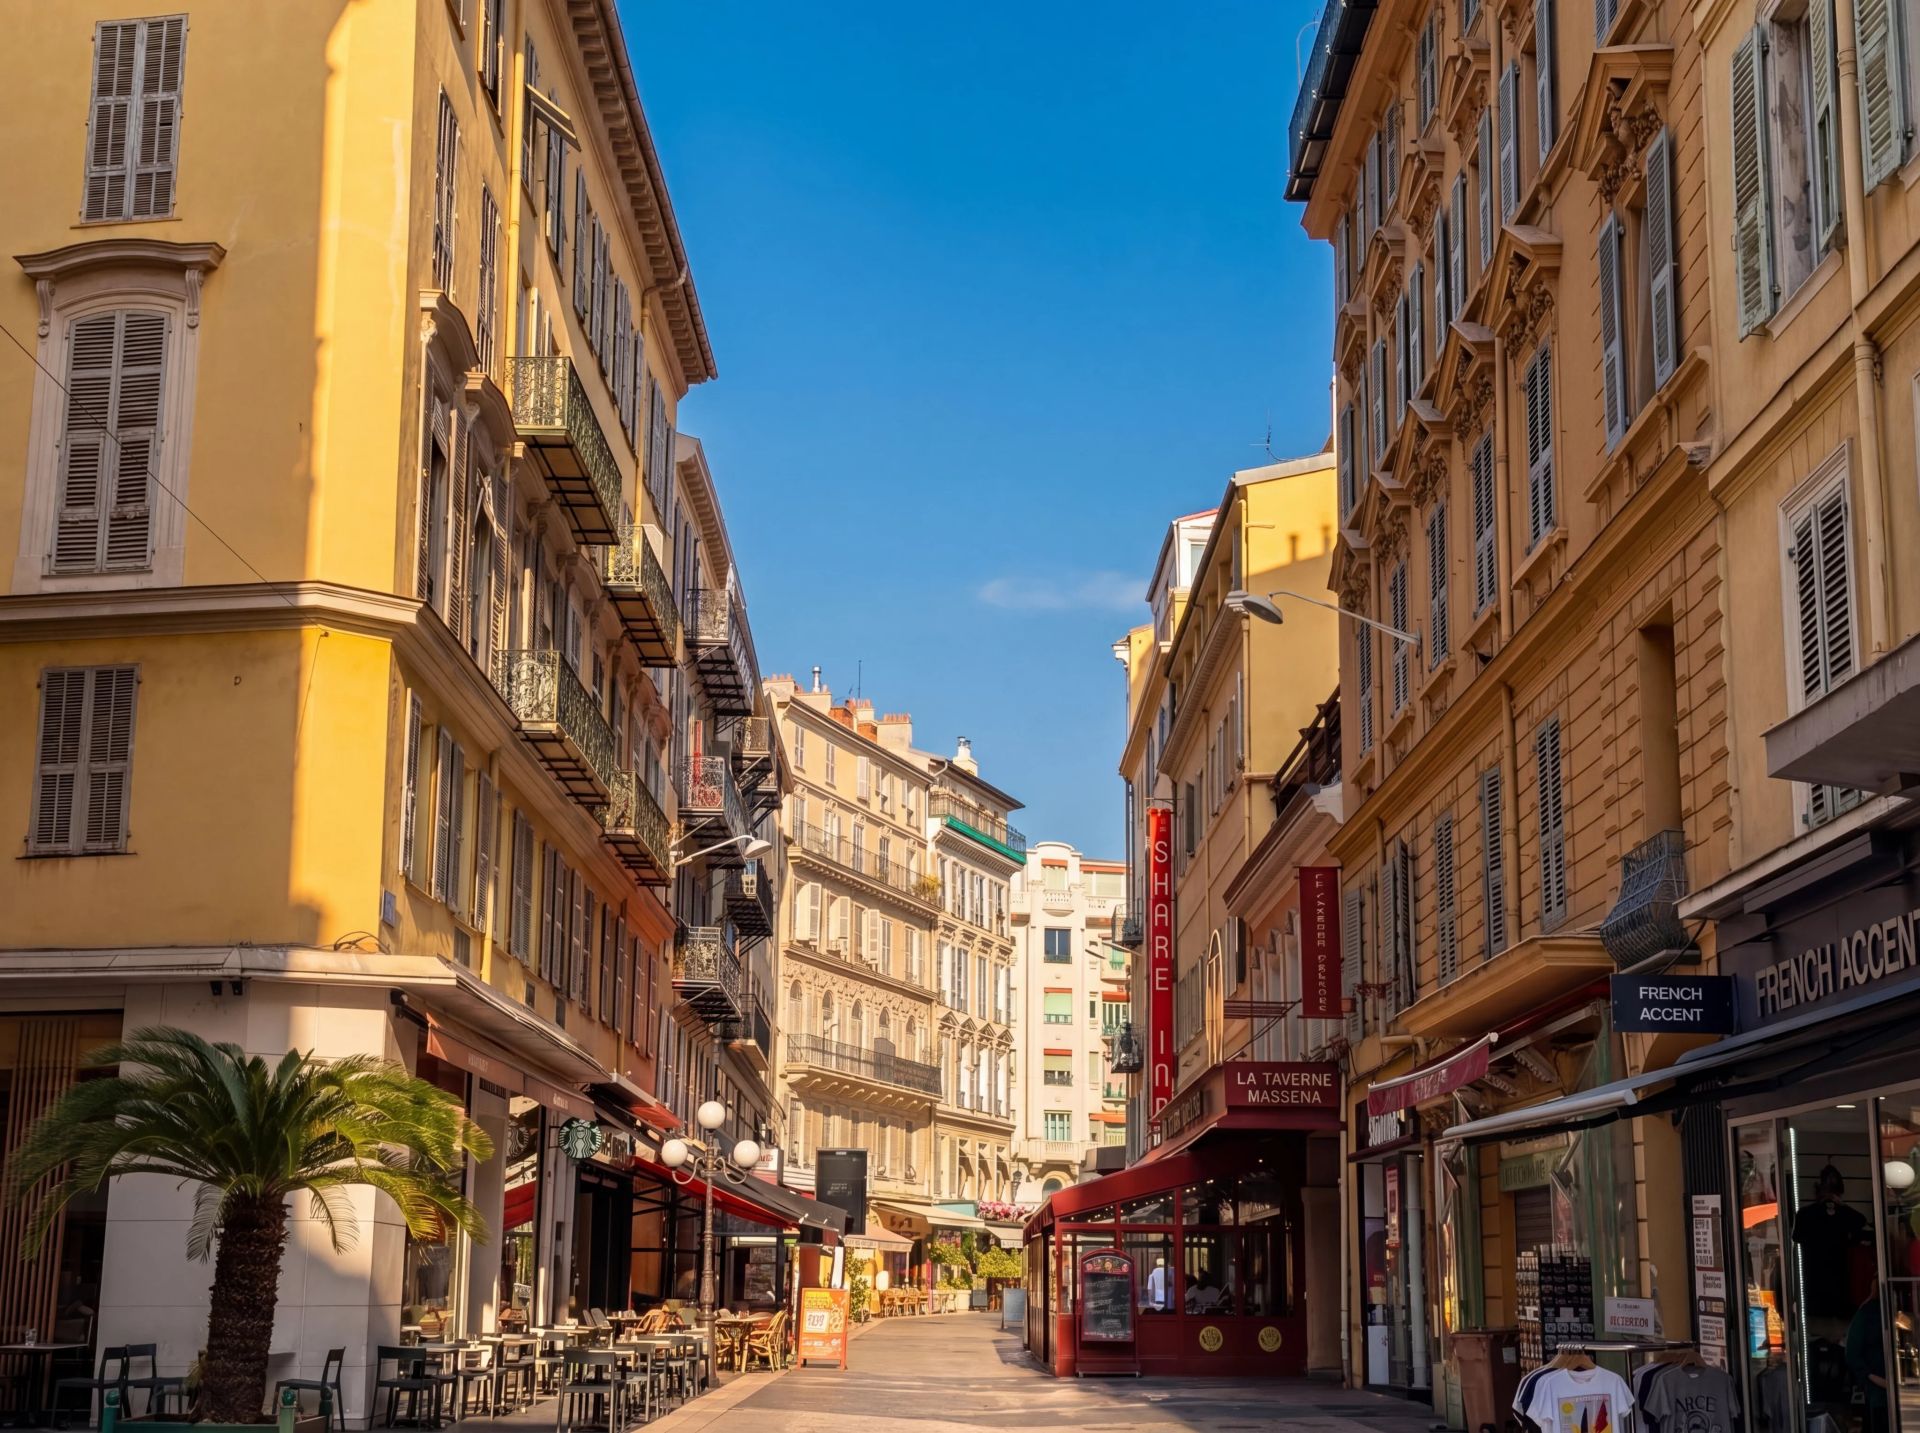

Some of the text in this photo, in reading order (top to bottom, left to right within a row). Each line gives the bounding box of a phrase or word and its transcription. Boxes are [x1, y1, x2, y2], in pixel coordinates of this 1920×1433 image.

[1154, 840, 1169, 991] SHARE
[1755, 943, 1833, 1018] FRENCH
[1639, 986, 1703, 1001] FRENCH
[1639, 1007, 1703, 1022] ACCENT
[1237, 1072, 1332, 1087] LA TAVERNE
[1248, 1089, 1322, 1104] MASSENA
